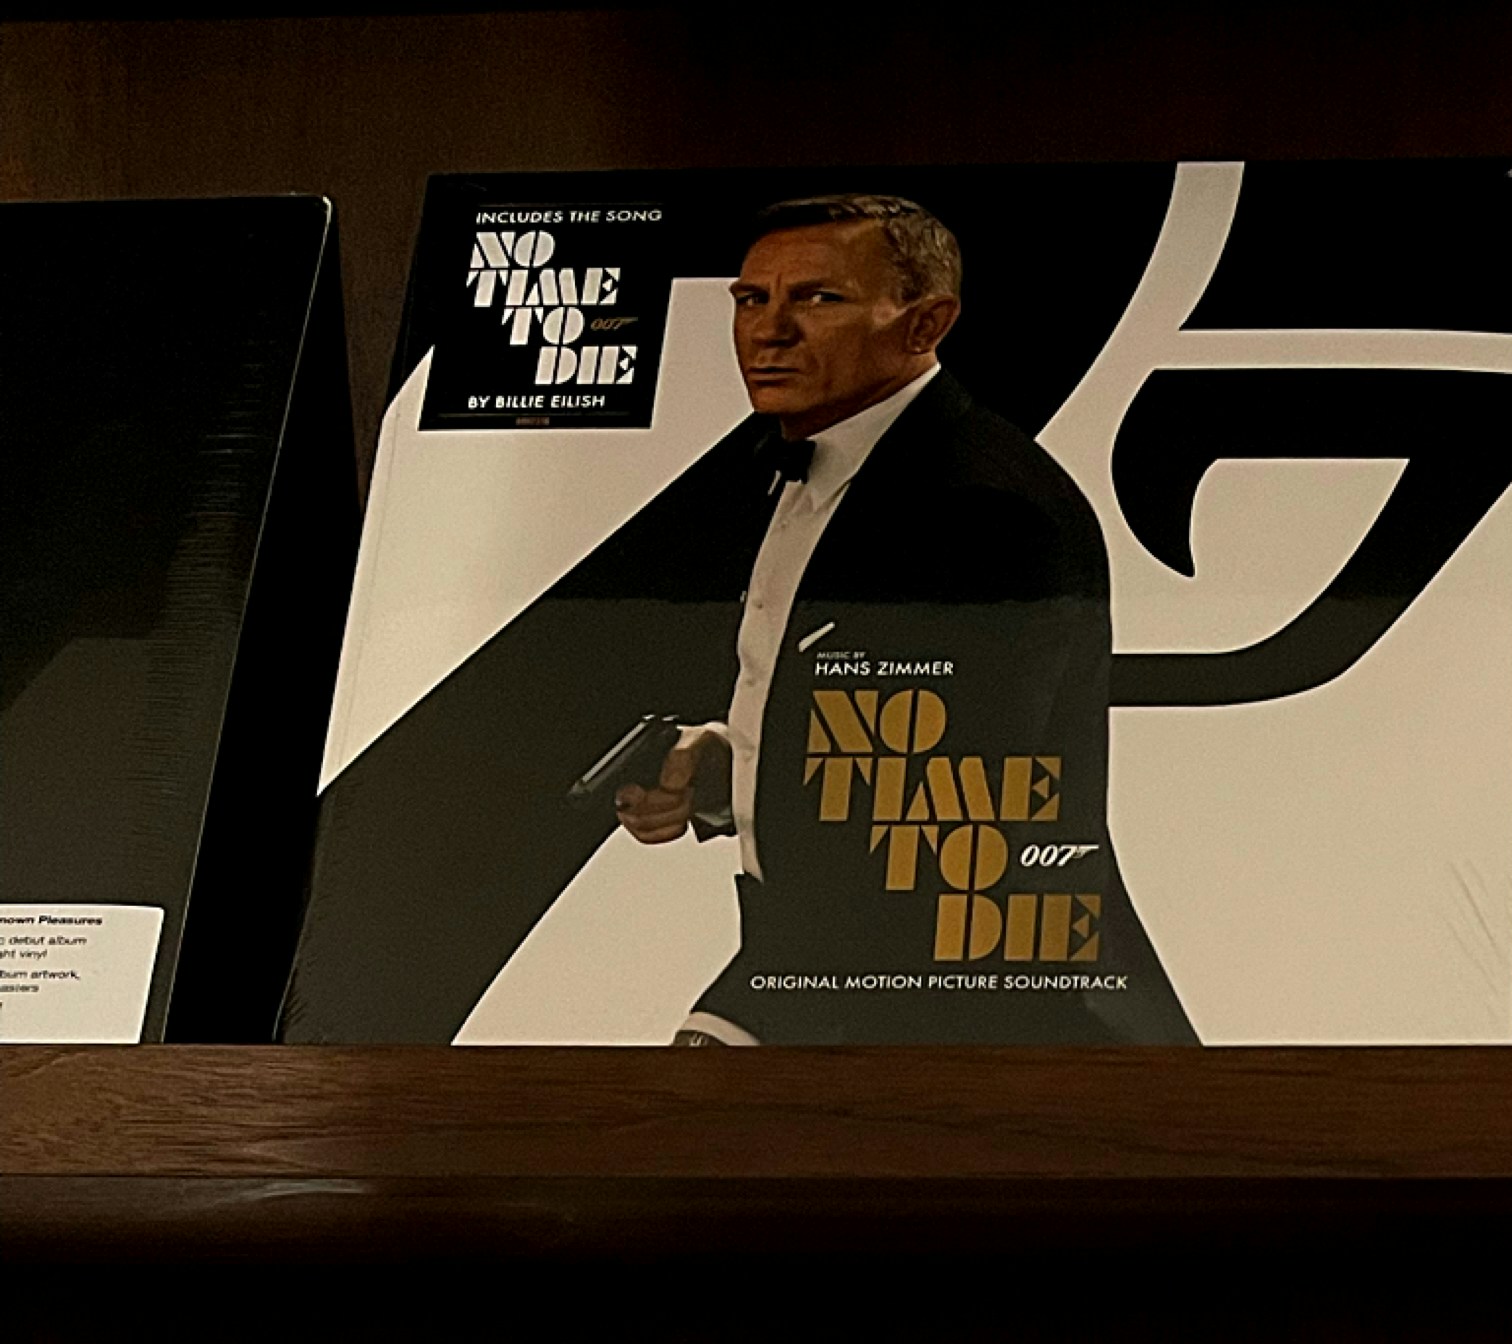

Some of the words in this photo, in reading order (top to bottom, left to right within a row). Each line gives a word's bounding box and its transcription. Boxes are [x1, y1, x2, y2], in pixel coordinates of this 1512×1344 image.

[475, 210, 564, 225] INCLUDES
[569, 210, 601, 224] THE
[605, 209, 663, 223] SONG
[469, 230, 556, 269] NO
[465, 267, 621, 308] TIME
[501, 306, 586, 346] TO
[590, 316, 639, 331] 007
[534, 345, 639, 385] DIE
[467, 395, 490, 409] BY
[495, 395, 545, 409] BILLIE
[550, 394, 606, 409] EILISH
[814, 661, 871, 677] HANS
[876, 661, 954, 677] ZIMMER
[805, 688, 948, 755] NO
[801, 754, 1063, 823] TIME
[868, 823, 1010, 892] TO
[1019, 843, 1100, 868] 007
[38, 914, 104, 926] Pleasures
[933, 893, 1102, 963] DIE
[8, 935, 46, 946] debut
[48, 935, 88, 946] album
[749, 974, 840, 991] ORIGINAL
[844, 974, 923, 991] MOTION
[927, 974, 999, 991] PICTURE
[1003, 974, 1129, 991] SOUNDTRACK
